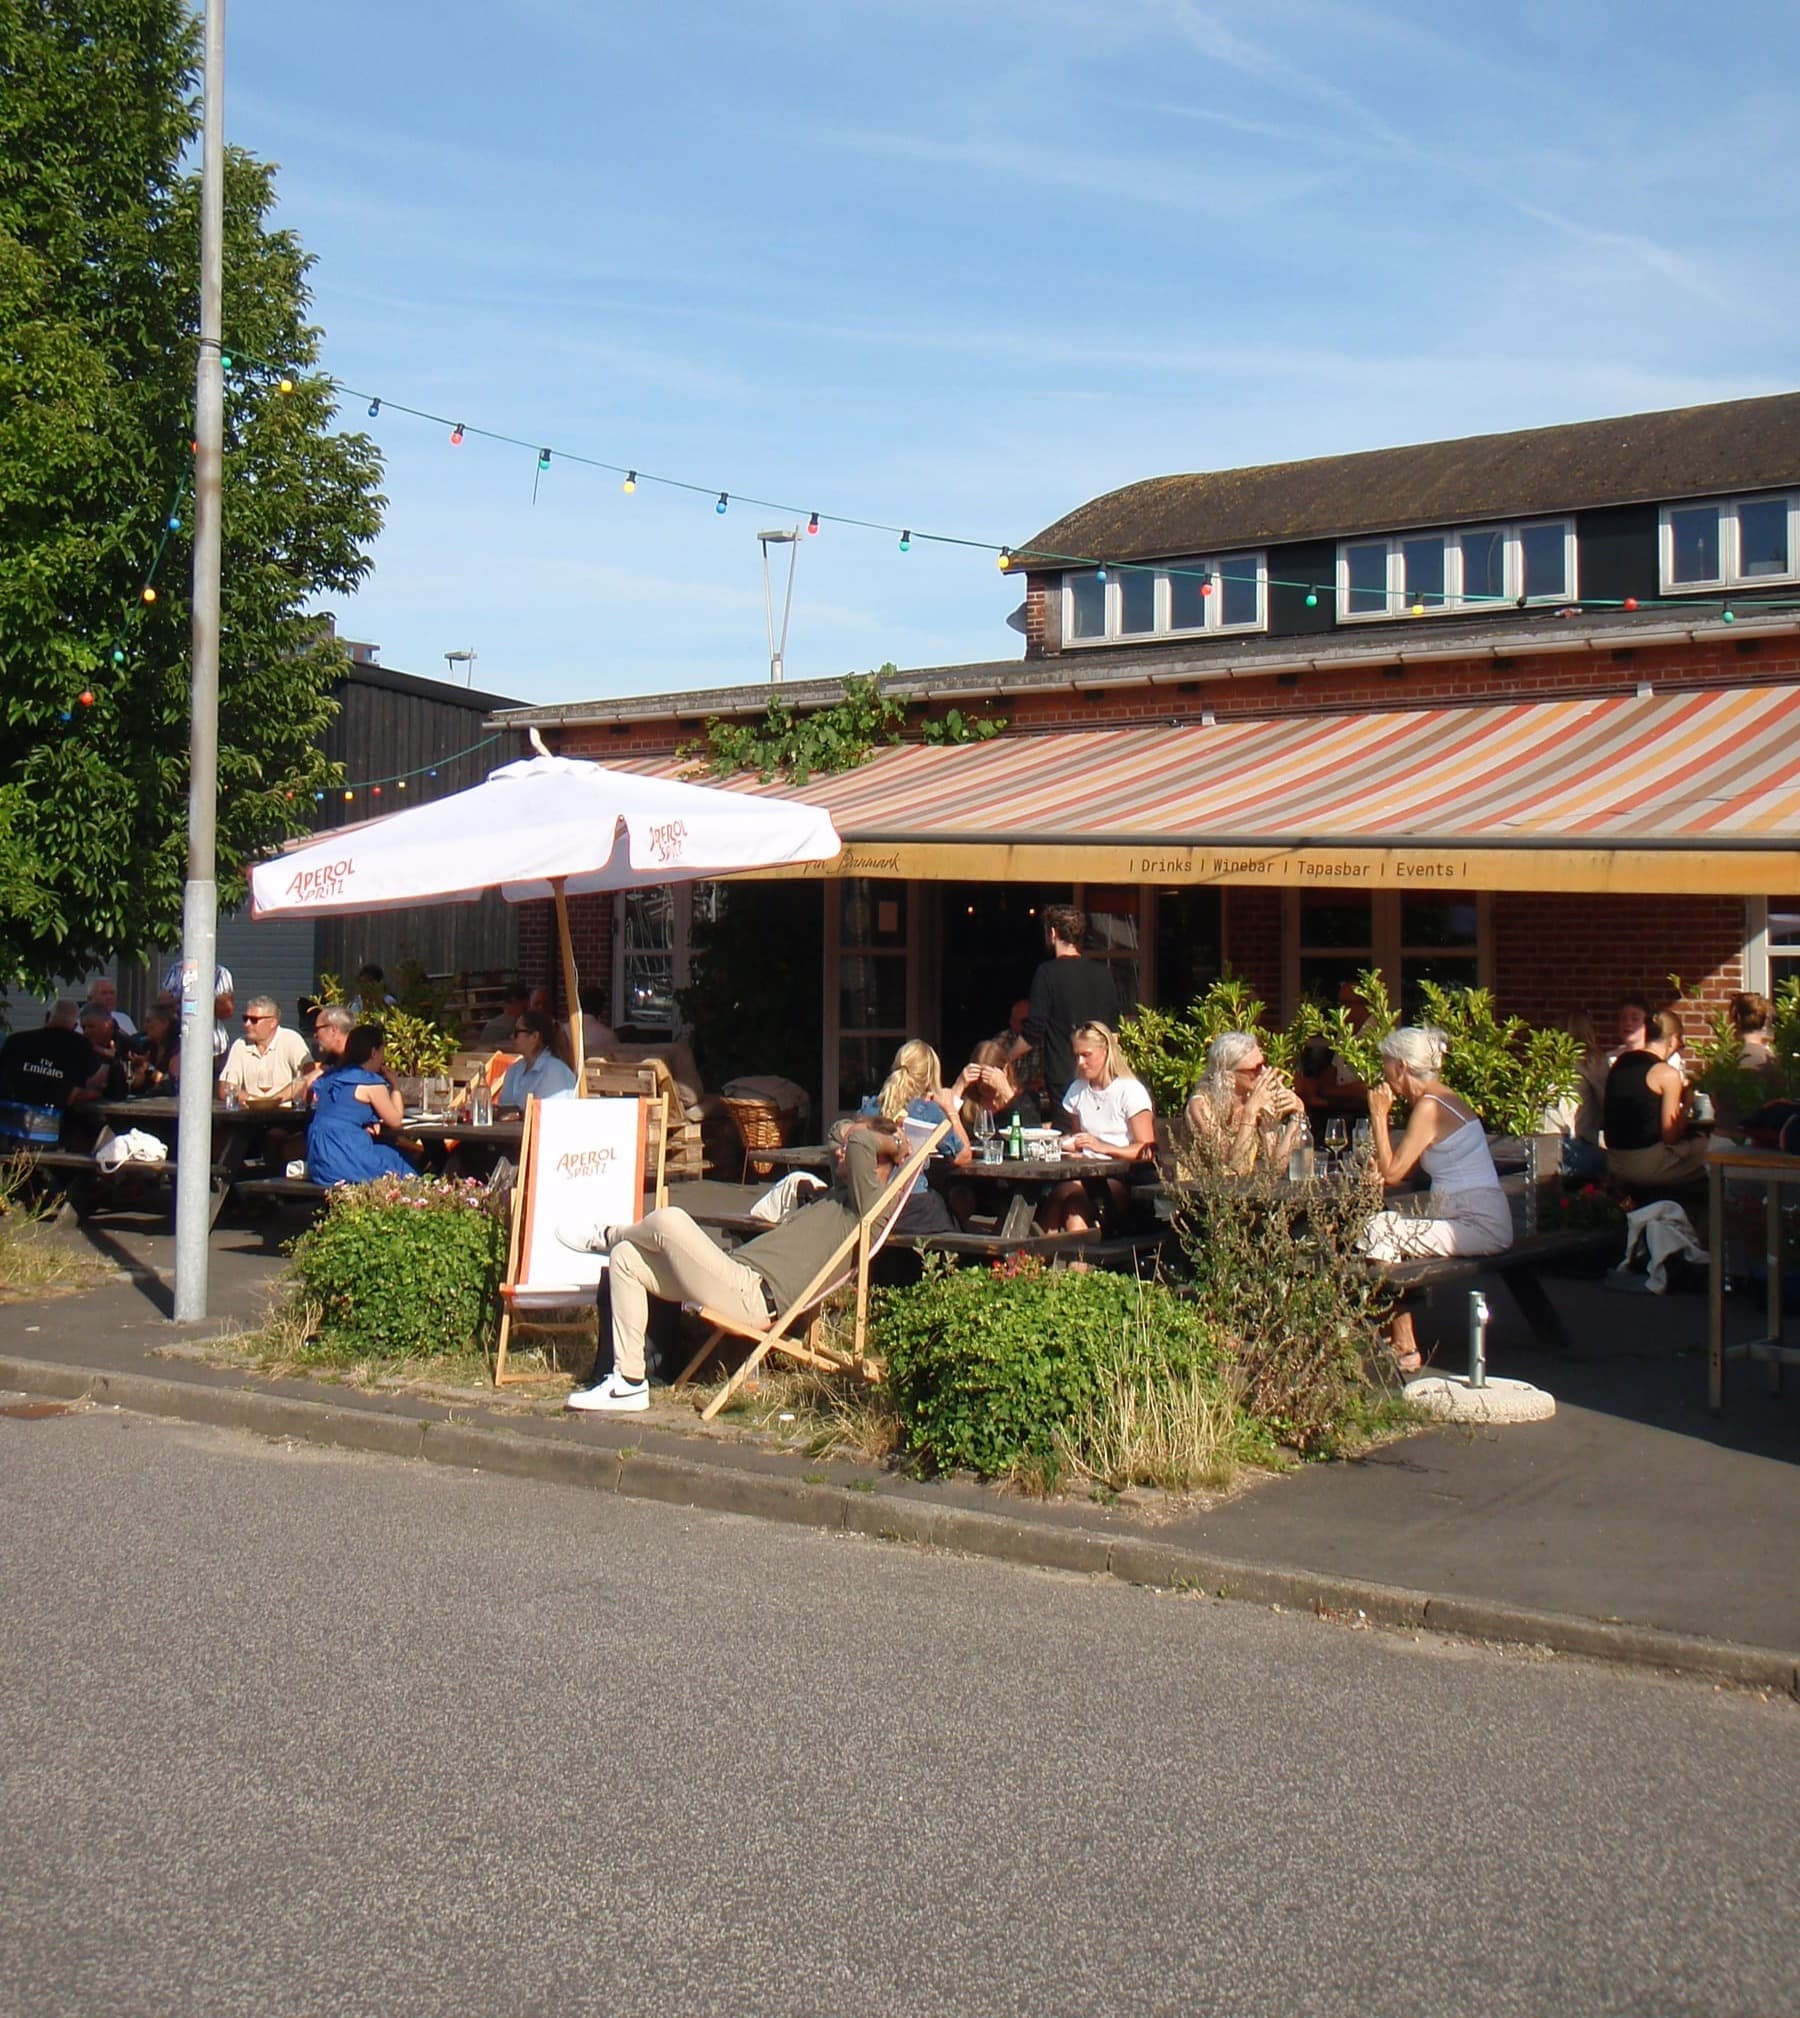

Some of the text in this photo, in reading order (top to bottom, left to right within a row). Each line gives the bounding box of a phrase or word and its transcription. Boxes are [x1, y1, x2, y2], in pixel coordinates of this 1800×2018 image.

[285, 858, 355, 895] APEROL
[1142, 858, 1192, 873] Drinks
[1214, 858, 1274, 873] Winebar
[1297, 861, 1371, 878] Tapasbar
[1396, 862, 1454, 877] Events
[556, 1146, 617, 1172] APEROL
